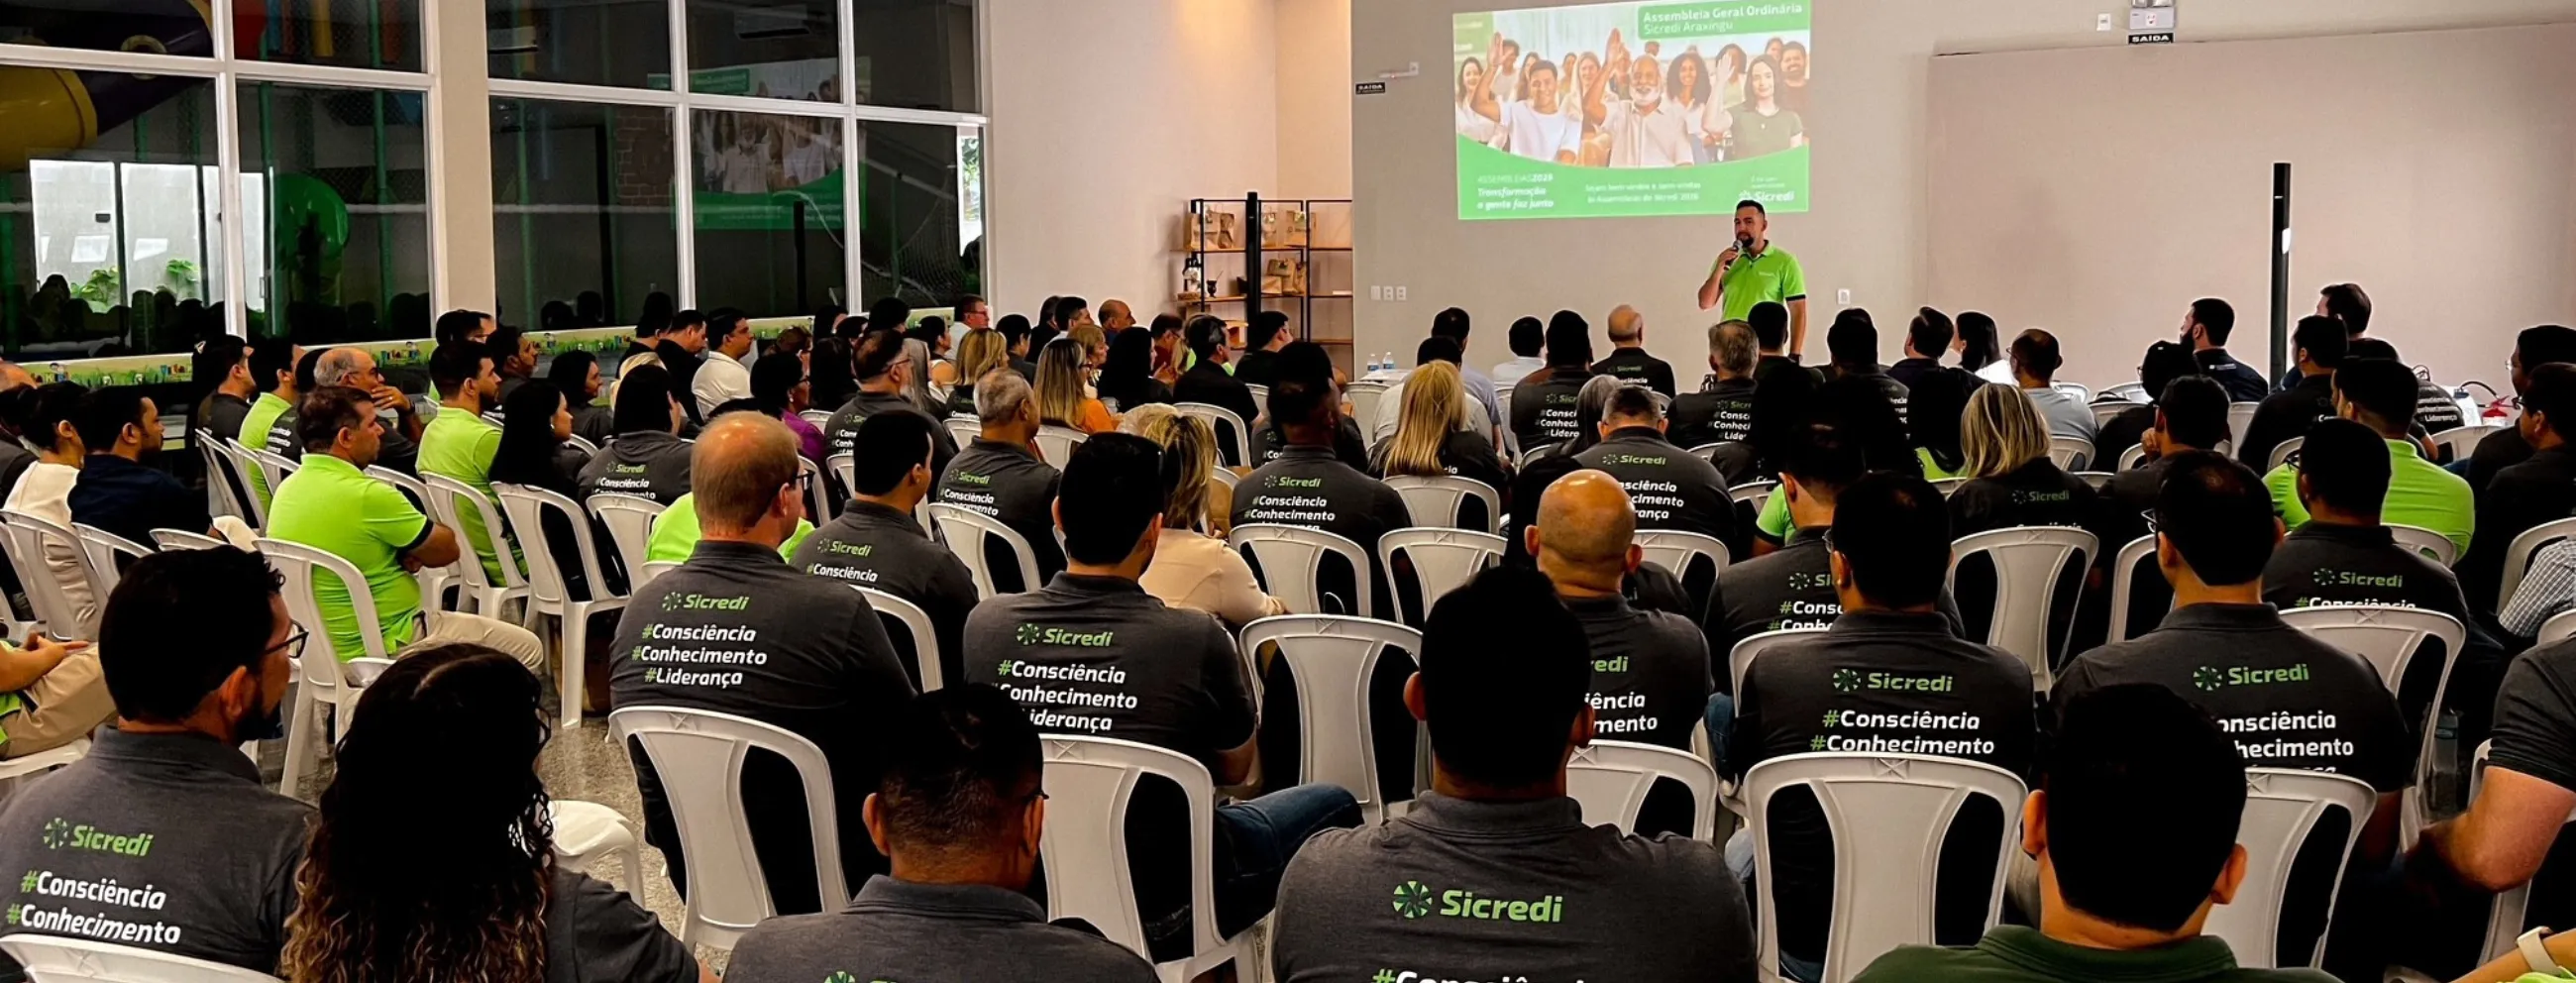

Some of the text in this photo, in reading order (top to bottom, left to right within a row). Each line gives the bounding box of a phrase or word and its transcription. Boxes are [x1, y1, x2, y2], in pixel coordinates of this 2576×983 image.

[1644, 3, 1803, 23] Assembleia Geral Ordinária
[1644, 22, 1734, 35] Sicredi Araxingu
[1754, 190, 1795, 202] Sicredi
[615, 464, 647, 474] Sicredi
[1620, 455, 1666, 465] Sicredi
[958, 471, 991, 485] Sicredi
[1278, 476, 1323, 488] Sicredi
[1251, 494, 1328, 507] #Consciência
[2028, 490, 2070, 501] Sicredi
[1243, 508, 1337, 521] #Conhecimento
[830, 540, 872, 557] Sicredi
[806, 563, 879, 583] #Consciência
[2338, 571, 2404, 588] Sicredi
[683, 594, 750, 610] Sicredi
[642, 623, 757, 642] #Consciência
[1042, 628, 1114, 647] Sicredi
[631, 645, 768, 665] #Conhecimento
[644, 667, 743, 690] #Liderança
[998, 659, 1127, 685] #Consciência
[1867, 672, 1953, 692] Sicredi
[2228, 663, 2309, 685] Sicredi
[992, 683, 1138, 710] onhecimento
[1029, 708, 1113, 733] iderança
[1822, 709, 1981, 730] #Consciência
[1810, 733, 1995, 755] #Conhecimento
[69, 824, 154, 856] Sicredi
[21, 870, 166, 911] #Consciência
[1440, 889, 1563, 924] Sicredi
[6, 903, 182, 944] #Conhecimento
